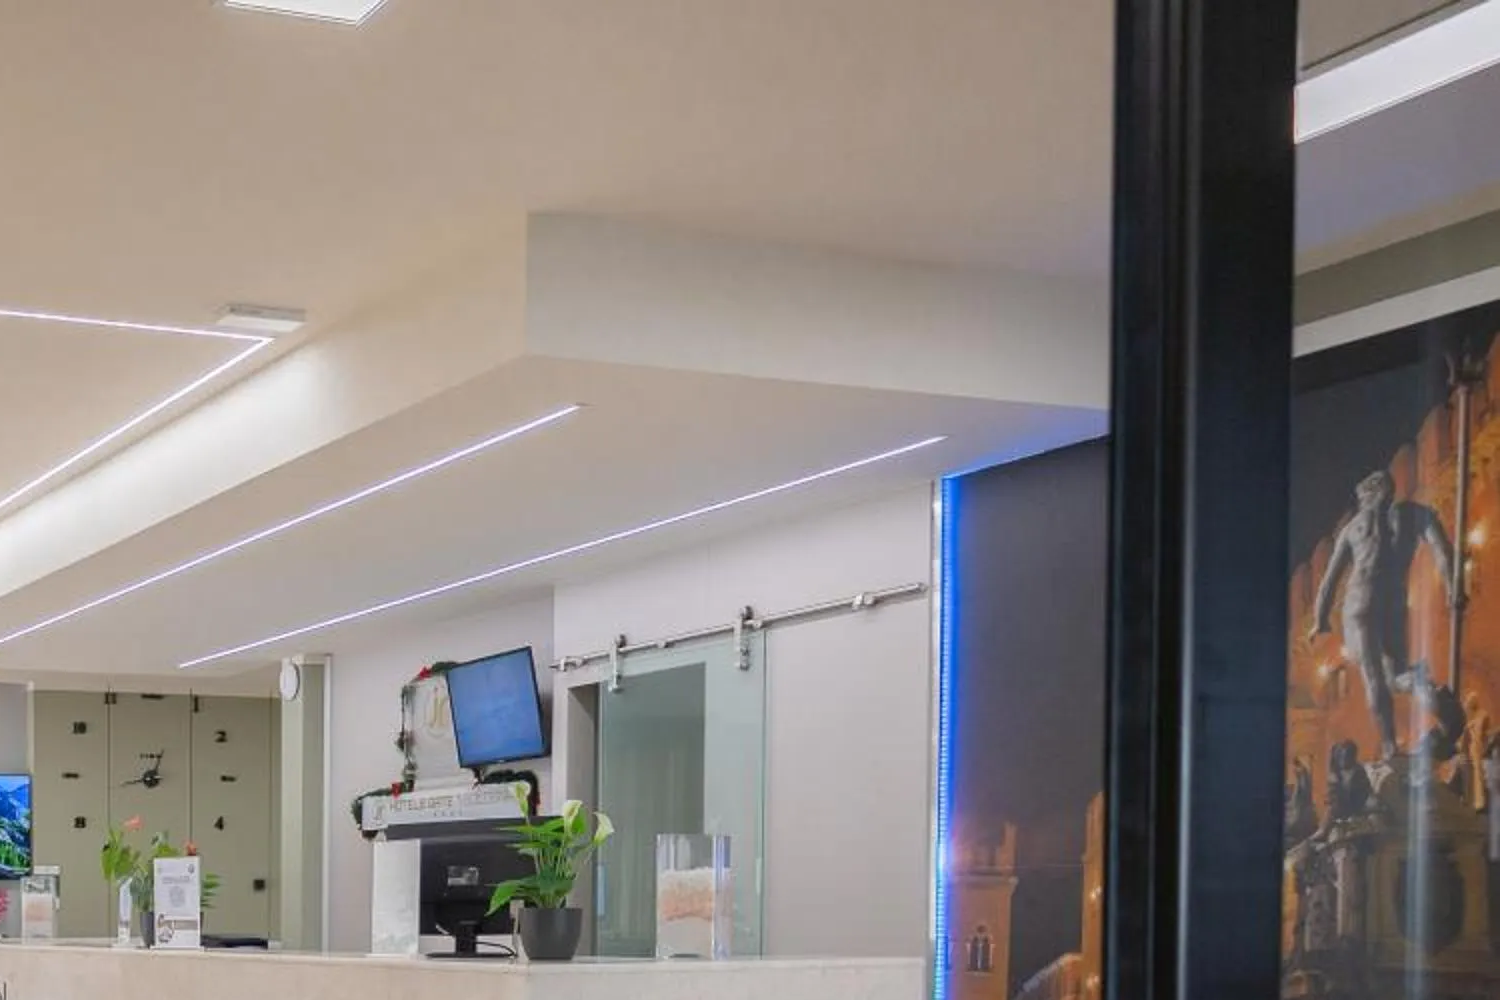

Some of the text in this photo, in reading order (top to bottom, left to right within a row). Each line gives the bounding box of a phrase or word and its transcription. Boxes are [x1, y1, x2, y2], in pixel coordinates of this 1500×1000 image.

[73, 721, 87, 735] 10
[214, 730, 228, 743] 2
[214, 816, 225, 831] 4
